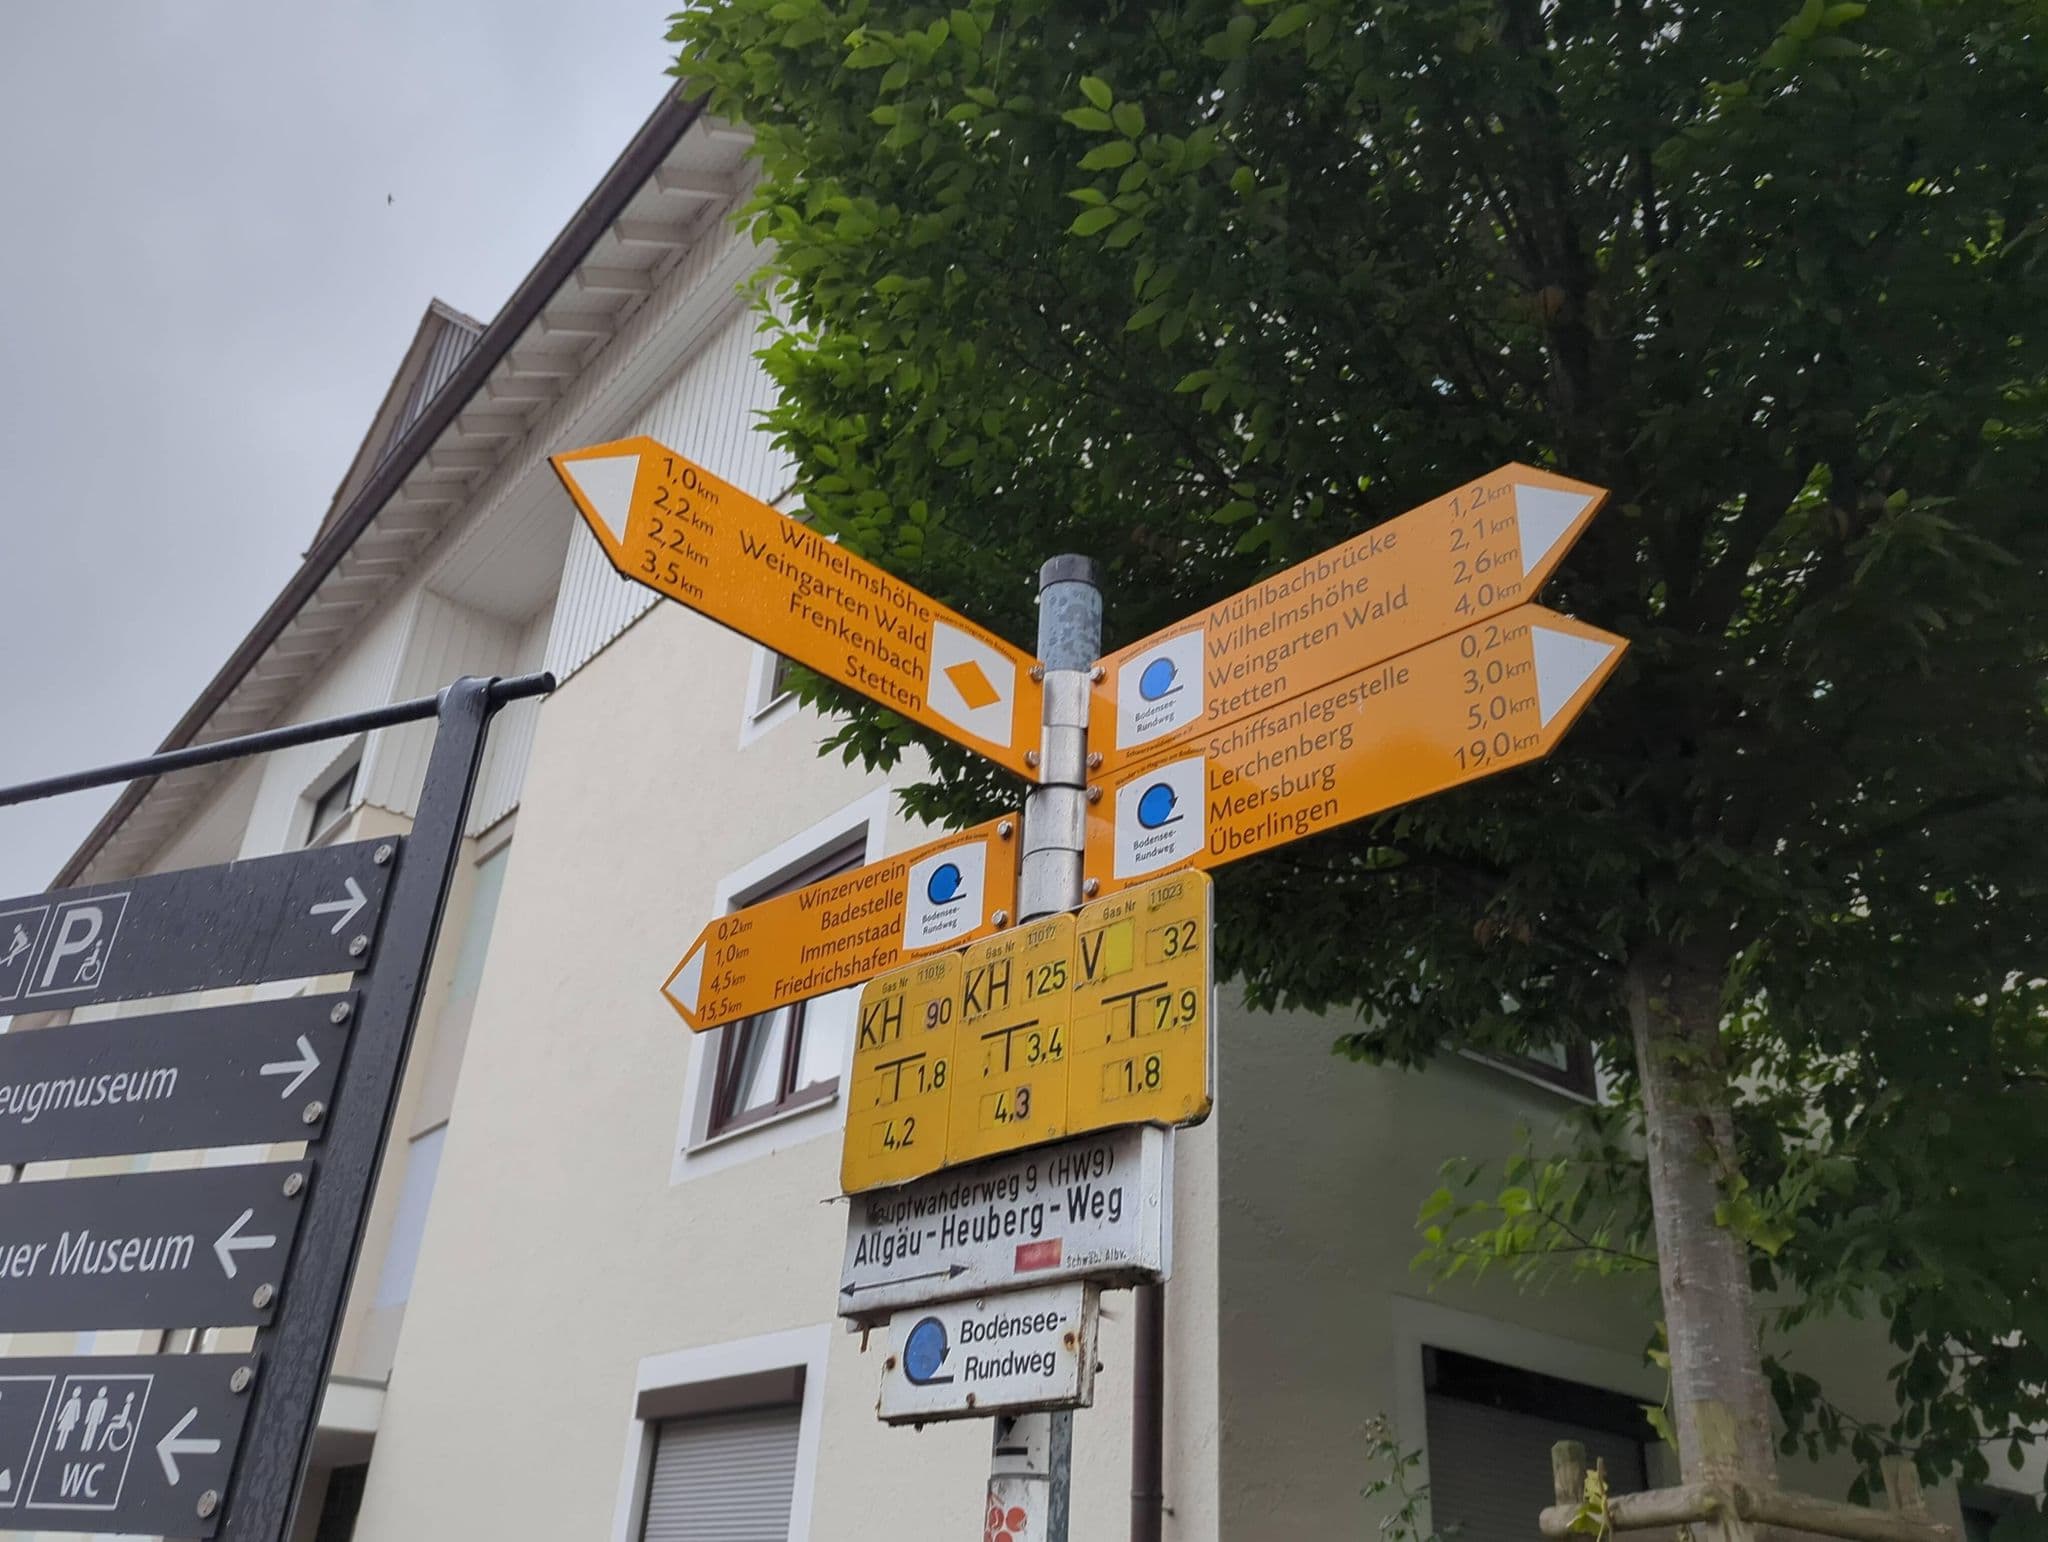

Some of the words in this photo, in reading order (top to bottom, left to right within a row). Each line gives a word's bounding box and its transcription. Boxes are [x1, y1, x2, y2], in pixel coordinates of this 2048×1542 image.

[739, 529, 868, 619] Weingarten
[873, 605, 927, 650] Wald
[779, 520, 931, 622] Wilhelmshöhe
[1209, 530, 1398, 631] Mühlbachbrücke
[789, 592, 924, 681] Frenkenbach
[1209, 575, 1369, 659] Wilhelmshöhe
[1209, 618, 1340, 689] Weingarten
[1344, 585, 1408, 631] Wald
[845, 655, 922, 712] Stetten
[1208, 676, 1287, 721] Stetten
[1137, 712, 1175, 733] Rundweg
[1209, 664, 1410, 760] Schiffsanlegestelle
[1209, 720, 1355, 790] Lerchenberg
[1210, 761, 1337, 825] Meersburg
[1134, 830, 1176, 850] Bodensee-
[1210, 798, 1339, 856] Überlingen
[1136, 842, 1175, 862] Rundweg
[799, 861, 905, 912] Winzerverein
[821, 890, 903, 931] Badestelle
[1125, 900, 1136, 912] Nr
[801, 913, 901, 964] Immenstaad
[1081, 930, 1104, 980] V
[1164, 921, 1197, 957] 32
[774, 947, 898, 999] Friedrichshafen
[963, 959, 1011, 1017] KH
[1026, 960, 1067, 999] 125
[859, 996, 903, 1049] KH
[926, 998, 952, 1029] 90
[1156, 990, 1196, 1030] 7,9
[1027, 1027, 1063, 1063] 3,4
[918, 1060, 946, 1094] 1,8
[1124, 1056, 1160, 1093] 1,8
[995, 1088, 1031, 1123] 4,3
[884, 1117, 915, 1150] 4,2
[1026, 1163, 1038, 1193] 9
[1048, 1145, 1115, 1188] (HW9)
[49, 1229, 196, 1276] Museum
[960, 1309, 1067, 1345] Bodensee-
[964, 1350, 1057, 1383] Rundweg
[59, 1463, 105, 1498] WC
